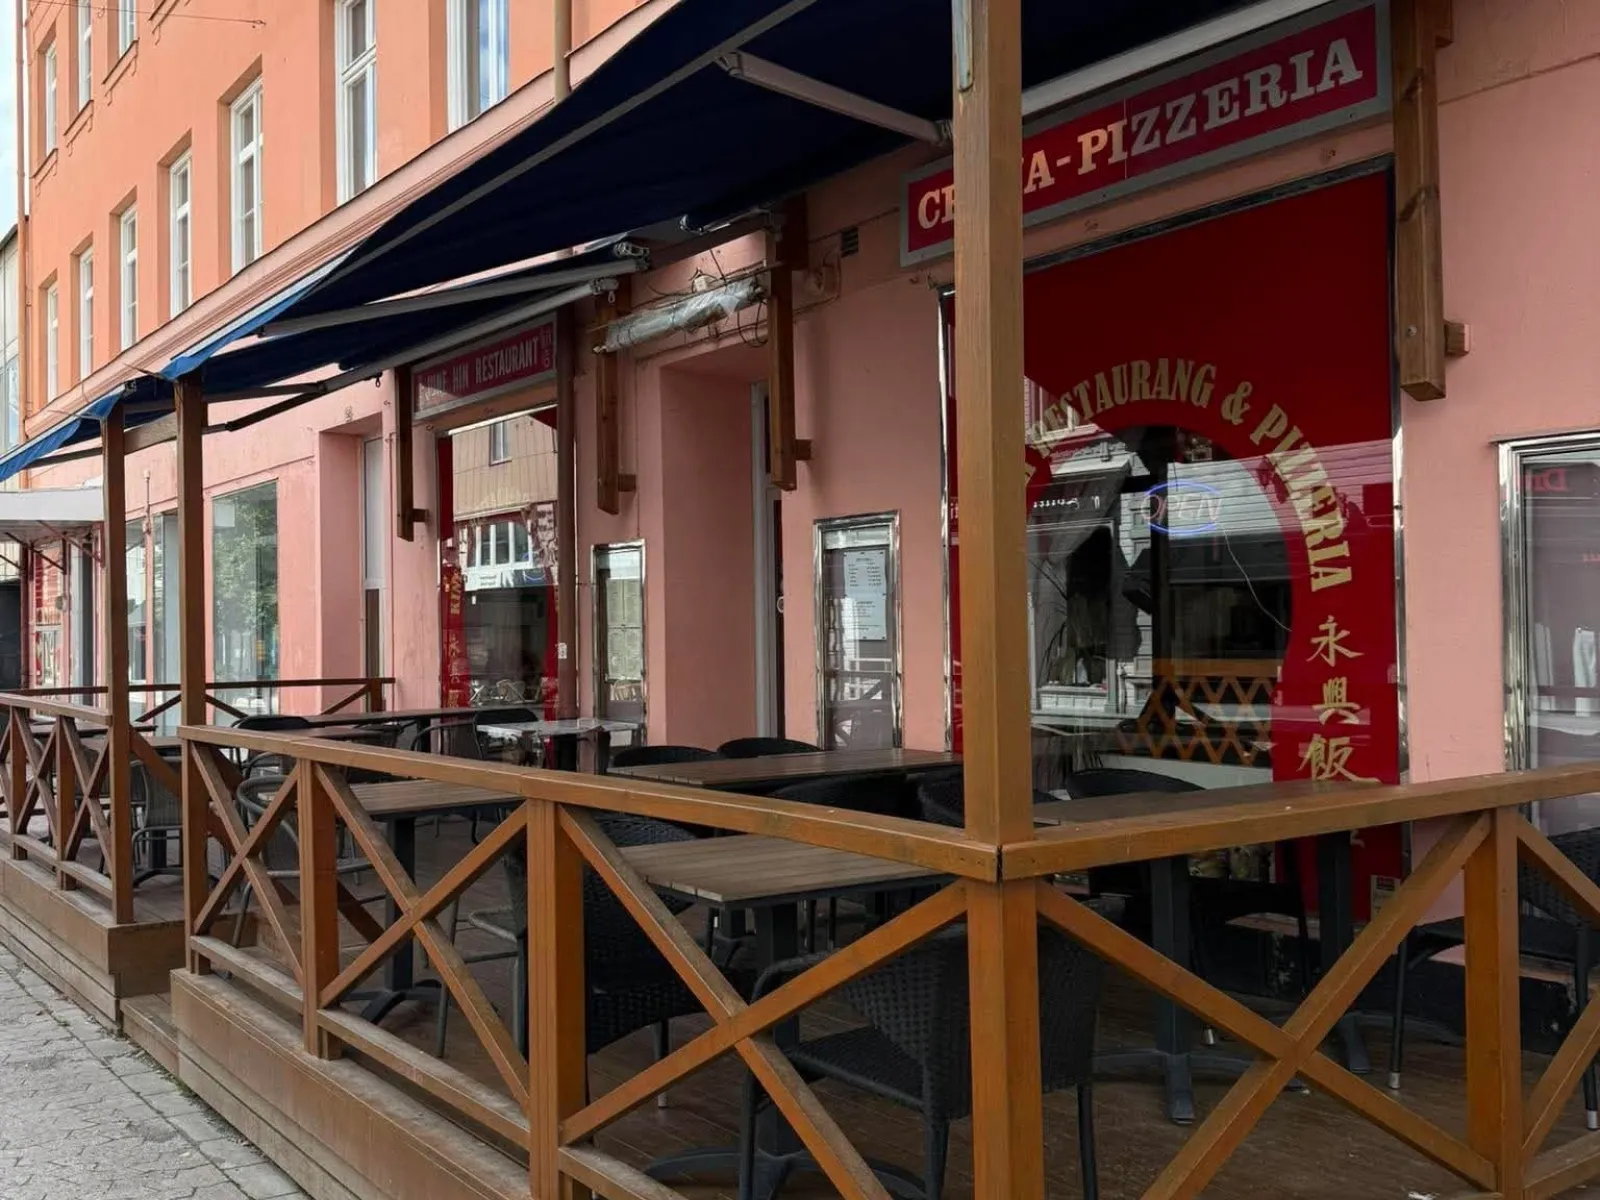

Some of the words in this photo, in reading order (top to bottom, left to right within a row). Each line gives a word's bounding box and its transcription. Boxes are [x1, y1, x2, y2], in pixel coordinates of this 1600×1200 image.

[918, 38, 1363, 230] CHA-PIZZERIA
[475, 338, 539, 385] RESTAURANT
[1031, 357, 1218, 459] RESTAURANG
[1221, 381, 1253, 425] &
[1250, 403, 1353, 592] PIZZERIA
[1140, 494, 1222, 522] OPEN
[1296, 614, 1381, 849] 永興飯
